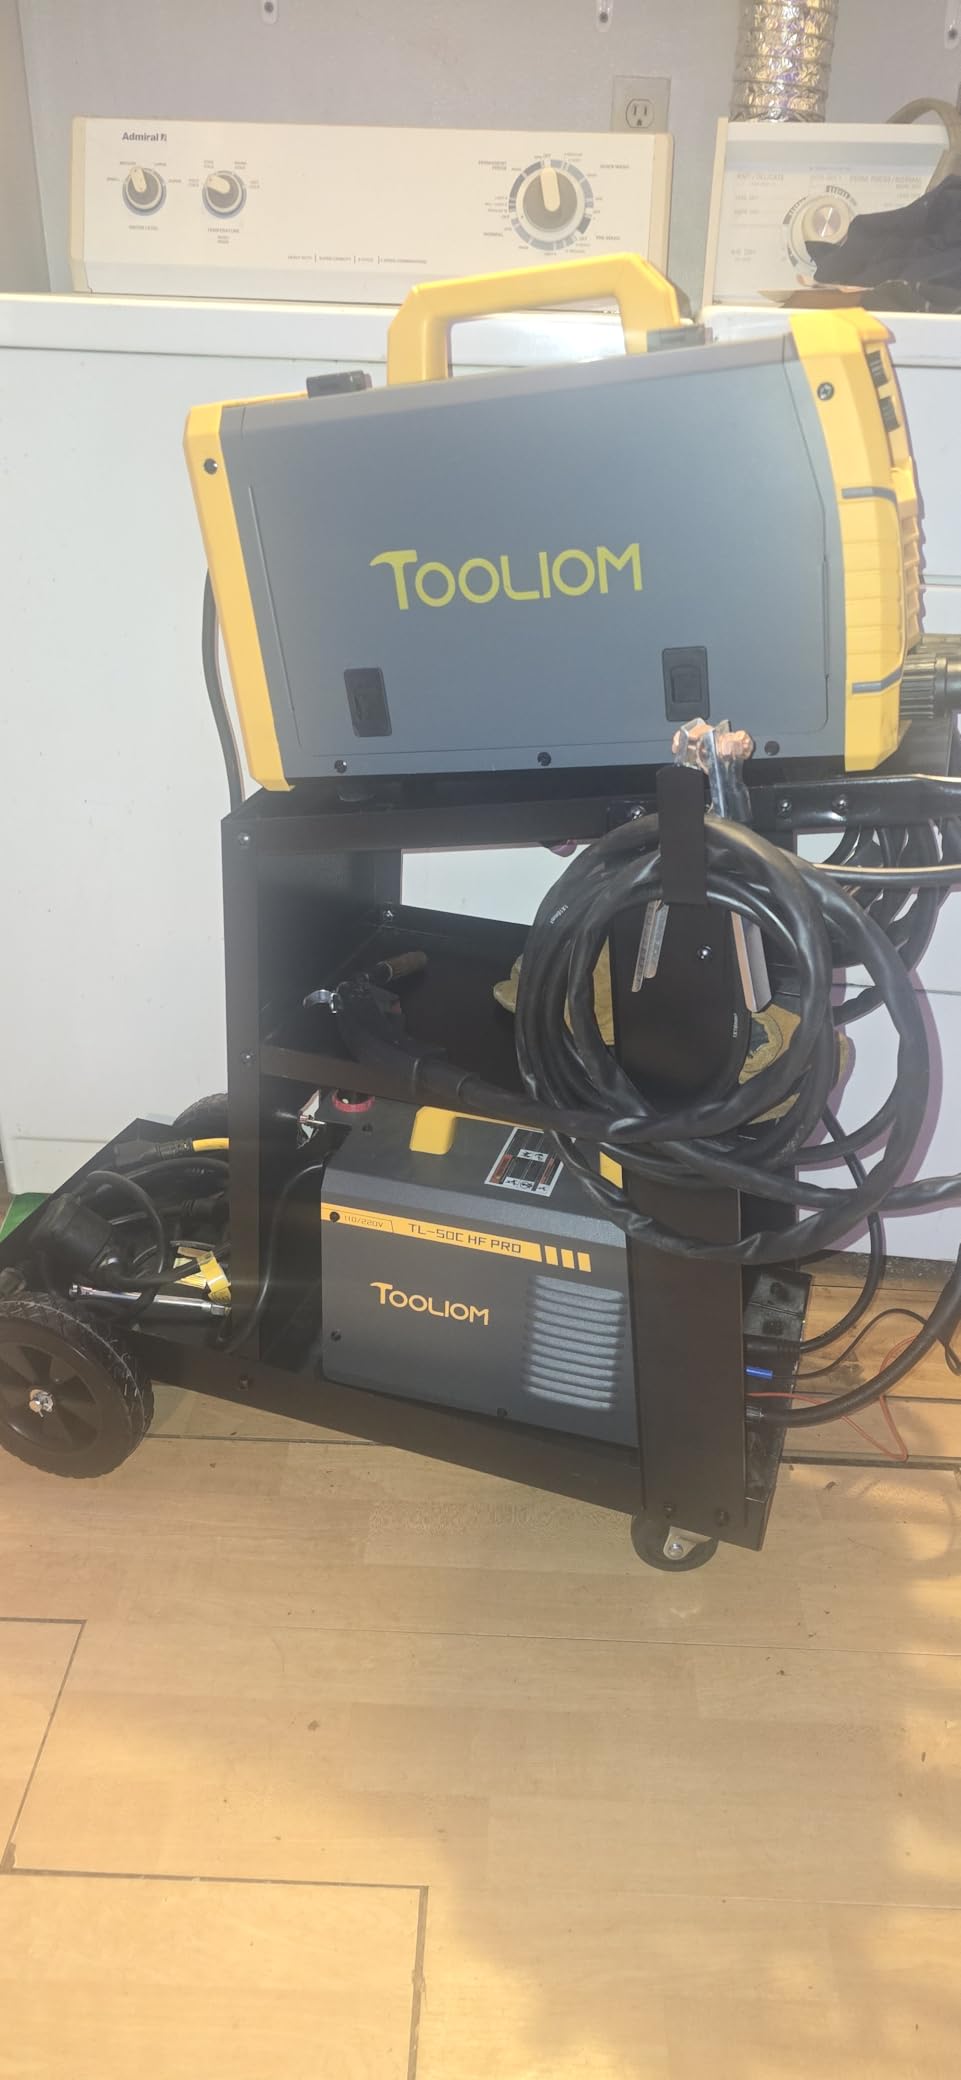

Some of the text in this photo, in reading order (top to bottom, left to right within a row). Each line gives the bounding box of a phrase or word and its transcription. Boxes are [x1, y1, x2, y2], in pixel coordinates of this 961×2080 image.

[122, 132, 158, 141] Admiral
[370, 543, 642, 610] TOOLIOM
[344, 1215, 384, 1228] 110/220V
[408, 1223, 521, 1253] TL-50C HF PRO
[370, 1281, 490, 1326] TOOLIOM
